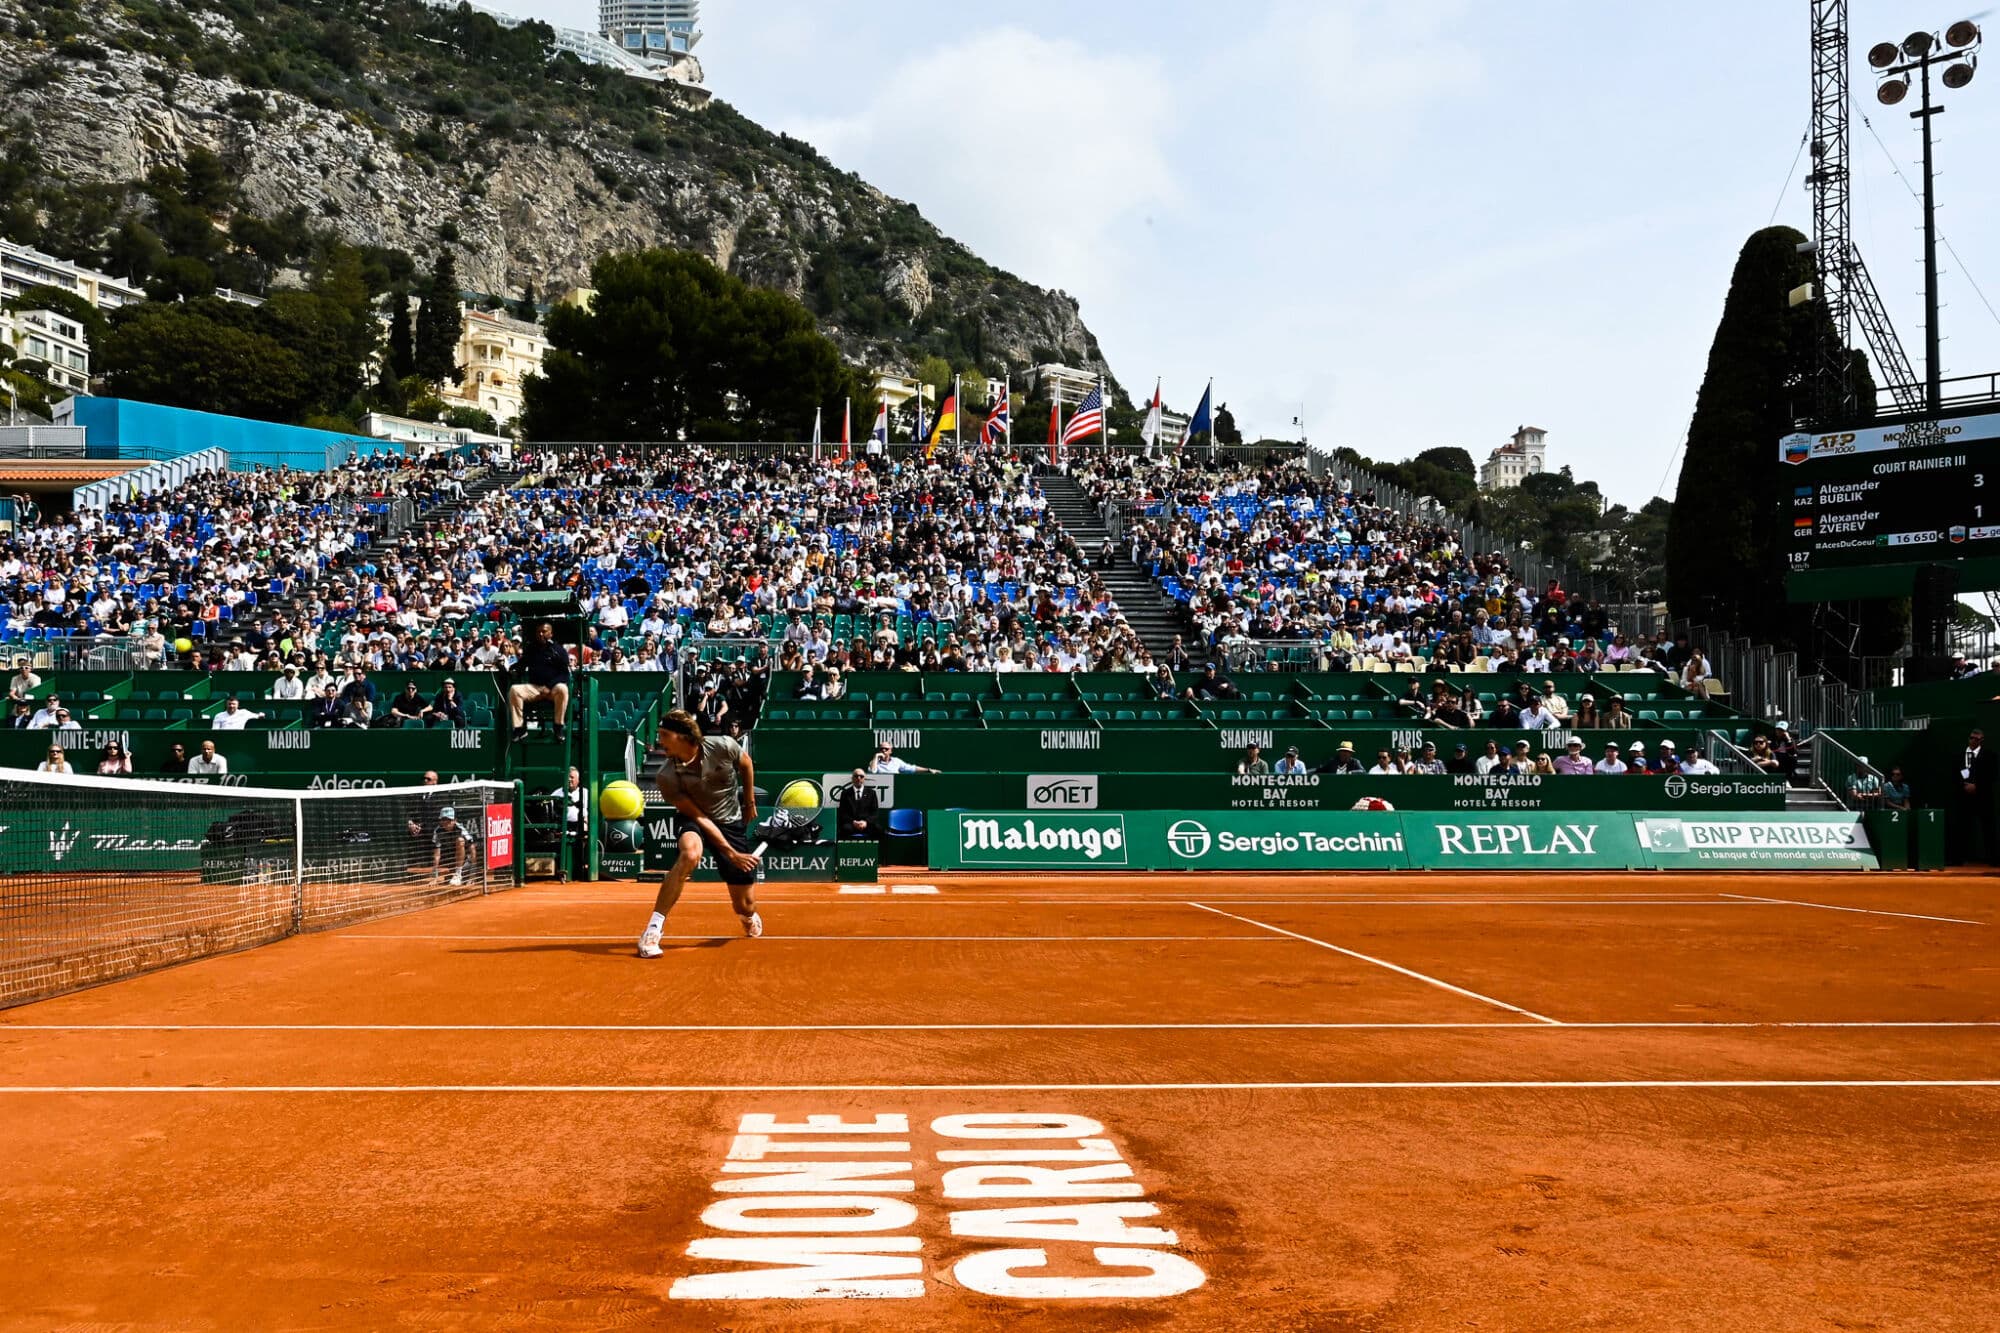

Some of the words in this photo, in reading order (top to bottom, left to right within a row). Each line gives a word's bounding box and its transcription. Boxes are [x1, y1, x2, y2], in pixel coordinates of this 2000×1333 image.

[1883, 425, 1962, 442] MONTE-CARLO
[1905, 420, 1939, 433] ROLEX
[1814, 433, 1856, 449] ATP
[1898, 436, 1946, 448] MASTERS
[1834, 446, 1855, 454] 1000
[1873, 461, 1907, 475] COURT
[1908, 456, 1952, 471] RAINIER
[1954, 455, 1966, 466] III
[1819, 480, 1880, 494] Alexander
[1973, 473, 1984, 487] 3
[1794, 497, 1813, 506] KAZ
[1819, 491, 1863, 504] BUBLIK
[1819, 510, 1880, 524] Alexander
[1974, 504, 1982, 518] 1
[1794, 528, 1813, 537] GER
[1819, 521, 1866, 534] ZVEREV
[1815, 539, 1876, 549] #AcesDuCoeur
[1896, 534, 1911, 543] 16
[1913, 532, 1936, 543] 650
[1787, 551, 1810, 562] 187
[267, 730, 311, 749] MADRID
[450, 730, 482, 749] ROME
[873, 730, 921, 749] TORONTO
[1041, 730, 1100, 749] CINCINNATI
[1220, 730, 1273, 749] SHANGHAI
[1391, 730, 1423, 749] PARIS
[1541, 730, 1572, 749] TURIN
[306, 773, 386, 791] Adecco
[1231, 775, 1320, 786] MONTE-CARLO
[1453, 775, 1542, 786] MONTE-CARLO
[1263, 788, 1288, 800] BAY
[1485, 788, 1510, 800] BAY
[1690, 781, 1731, 796] Sergio
[1732, 781, 1786, 794] Tacchini
[1231, 800, 1265, 808] HOTEL
[1268, 800, 1275, 808] &
[1279, 800, 1320, 808] RESORT
[1453, 800, 1487, 808] HOTEL
[1490, 800, 1497, 808] &
[1501, 800, 1542, 808] RESORT
[1891, 810, 1899, 822] 2
[1928, 810, 1935, 822] 1
[962, 818, 1121, 859] Malongo
[1435, 824, 1599, 855] REPLAY
[1690, 825, 1742, 845] BNP
[1749, 825, 1855, 845] PARIBAS
[1217, 831, 1299, 855] Sergio
[1299, 831, 1403, 851] Tacchini
[601, 859, 636, 867] OFFICIAL
[768, 856, 830, 871] REPLAY
[839, 857, 876, 868] REPLAY
[1699, 851, 1710, 859] La
[1712, 850, 1748, 861] banque
[1750, 850, 1771, 859] d'un
[1773, 850, 1807, 859] monde
[1809, 850, 1825, 861] qui
[1826, 850, 1862, 862] change
[668, 1112, 926, 1300] MONTE
[930, 1112, 1208, 1299] CARLO
